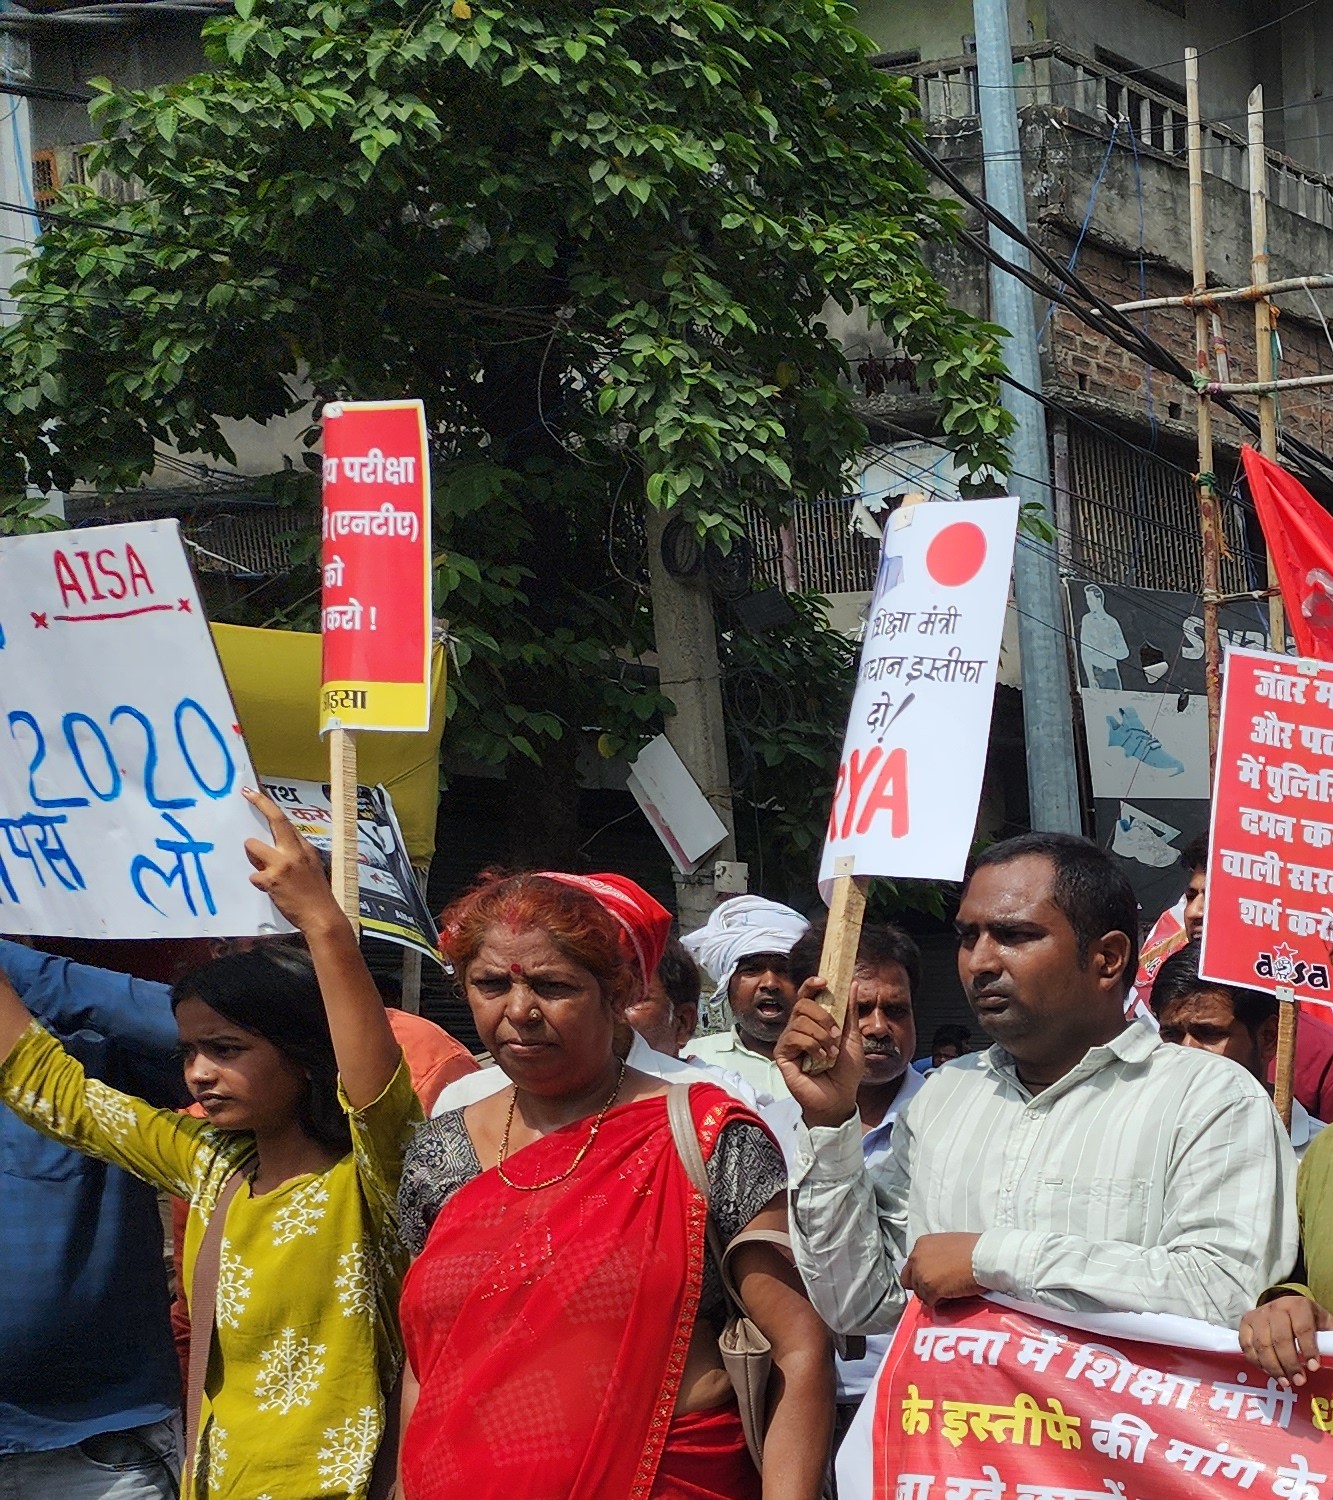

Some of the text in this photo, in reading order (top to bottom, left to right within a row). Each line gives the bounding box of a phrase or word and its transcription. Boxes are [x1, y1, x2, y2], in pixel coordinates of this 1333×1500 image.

[341, 447, 416, 485] परीक्षा
[53, 542, 155, 609] AISA
[324, 554, 345, 588] को
[326, 597, 363, 631] करो
[917, 605, 962, 636] मंत्री
[904, 646, 989, 686] इस्तीफा
[1253, 665, 1311, 704] जंतर
[1250, 710, 1296, 749] और
[8, 697, 236, 809] 2020
[1237, 753, 1266, 790] में
[1239, 806, 1297, 843] दमन
[0, 811, 215, 917] ापस लो
[1220, 848, 1284, 887] वाली
[1239, 897, 1283, 931] शर्म
[913, 1327, 1011, 1365] पटना
[1017, 1330, 1072, 1373] में
[1065, 1343, 1200, 1411] शिक्षा
[1208, 1371, 1298, 1429] मंत्री
[901, 1384, 934, 1436] के
[940, 1393, 1082, 1451] इस्तीफे
[1091, 1412, 1158, 1464] की
[1165, 1438, 1266, 1489] मांग
